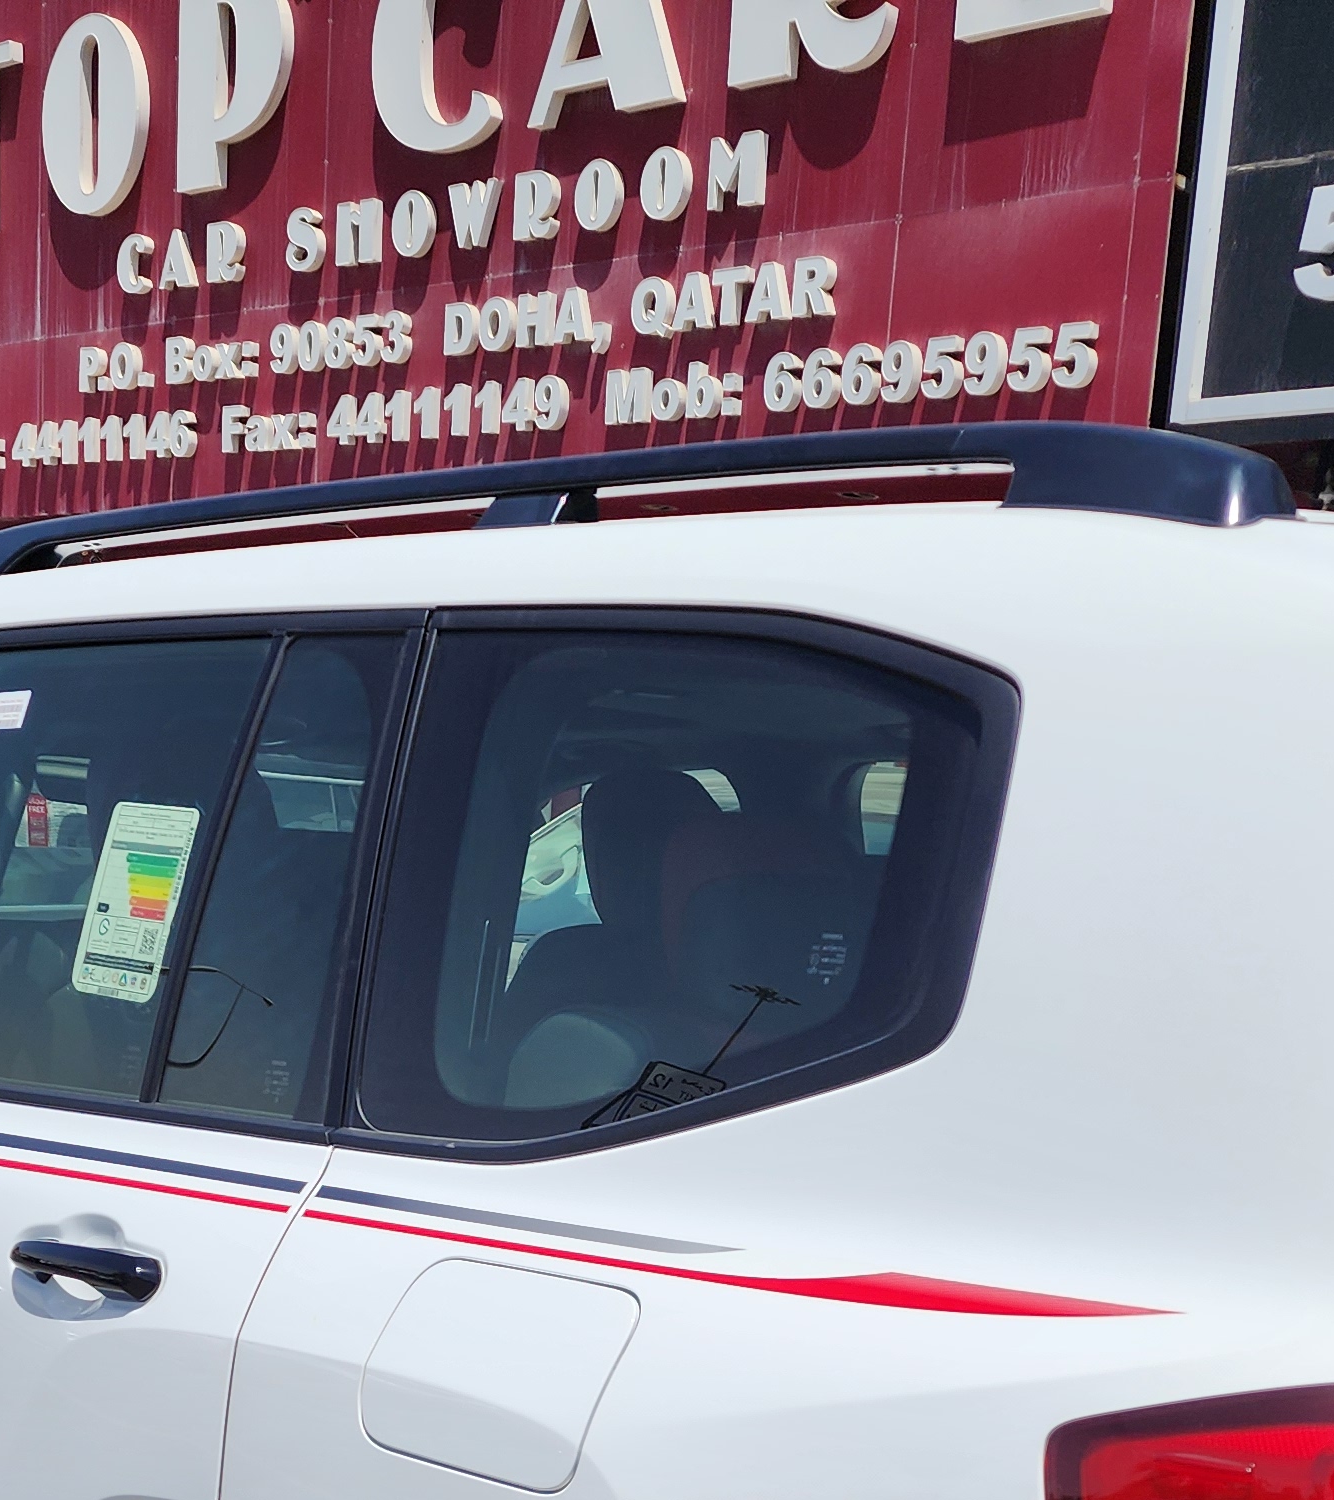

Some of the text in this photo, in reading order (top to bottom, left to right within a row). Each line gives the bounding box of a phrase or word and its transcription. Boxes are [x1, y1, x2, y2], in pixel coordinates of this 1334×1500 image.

[117, 129, 769, 295] CAR SHOWROOM
[11, 410, 198, 468] 44111146
[221, 404, 317, 454] Fax:
[326, 373, 569, 444] 44111149
[604, 361, 743, 425] Mob:
[764, 320, 1099, 412] 66695955
[78, 255, 838, 393] P.O. Box: 90853 DOHA, QATAR
